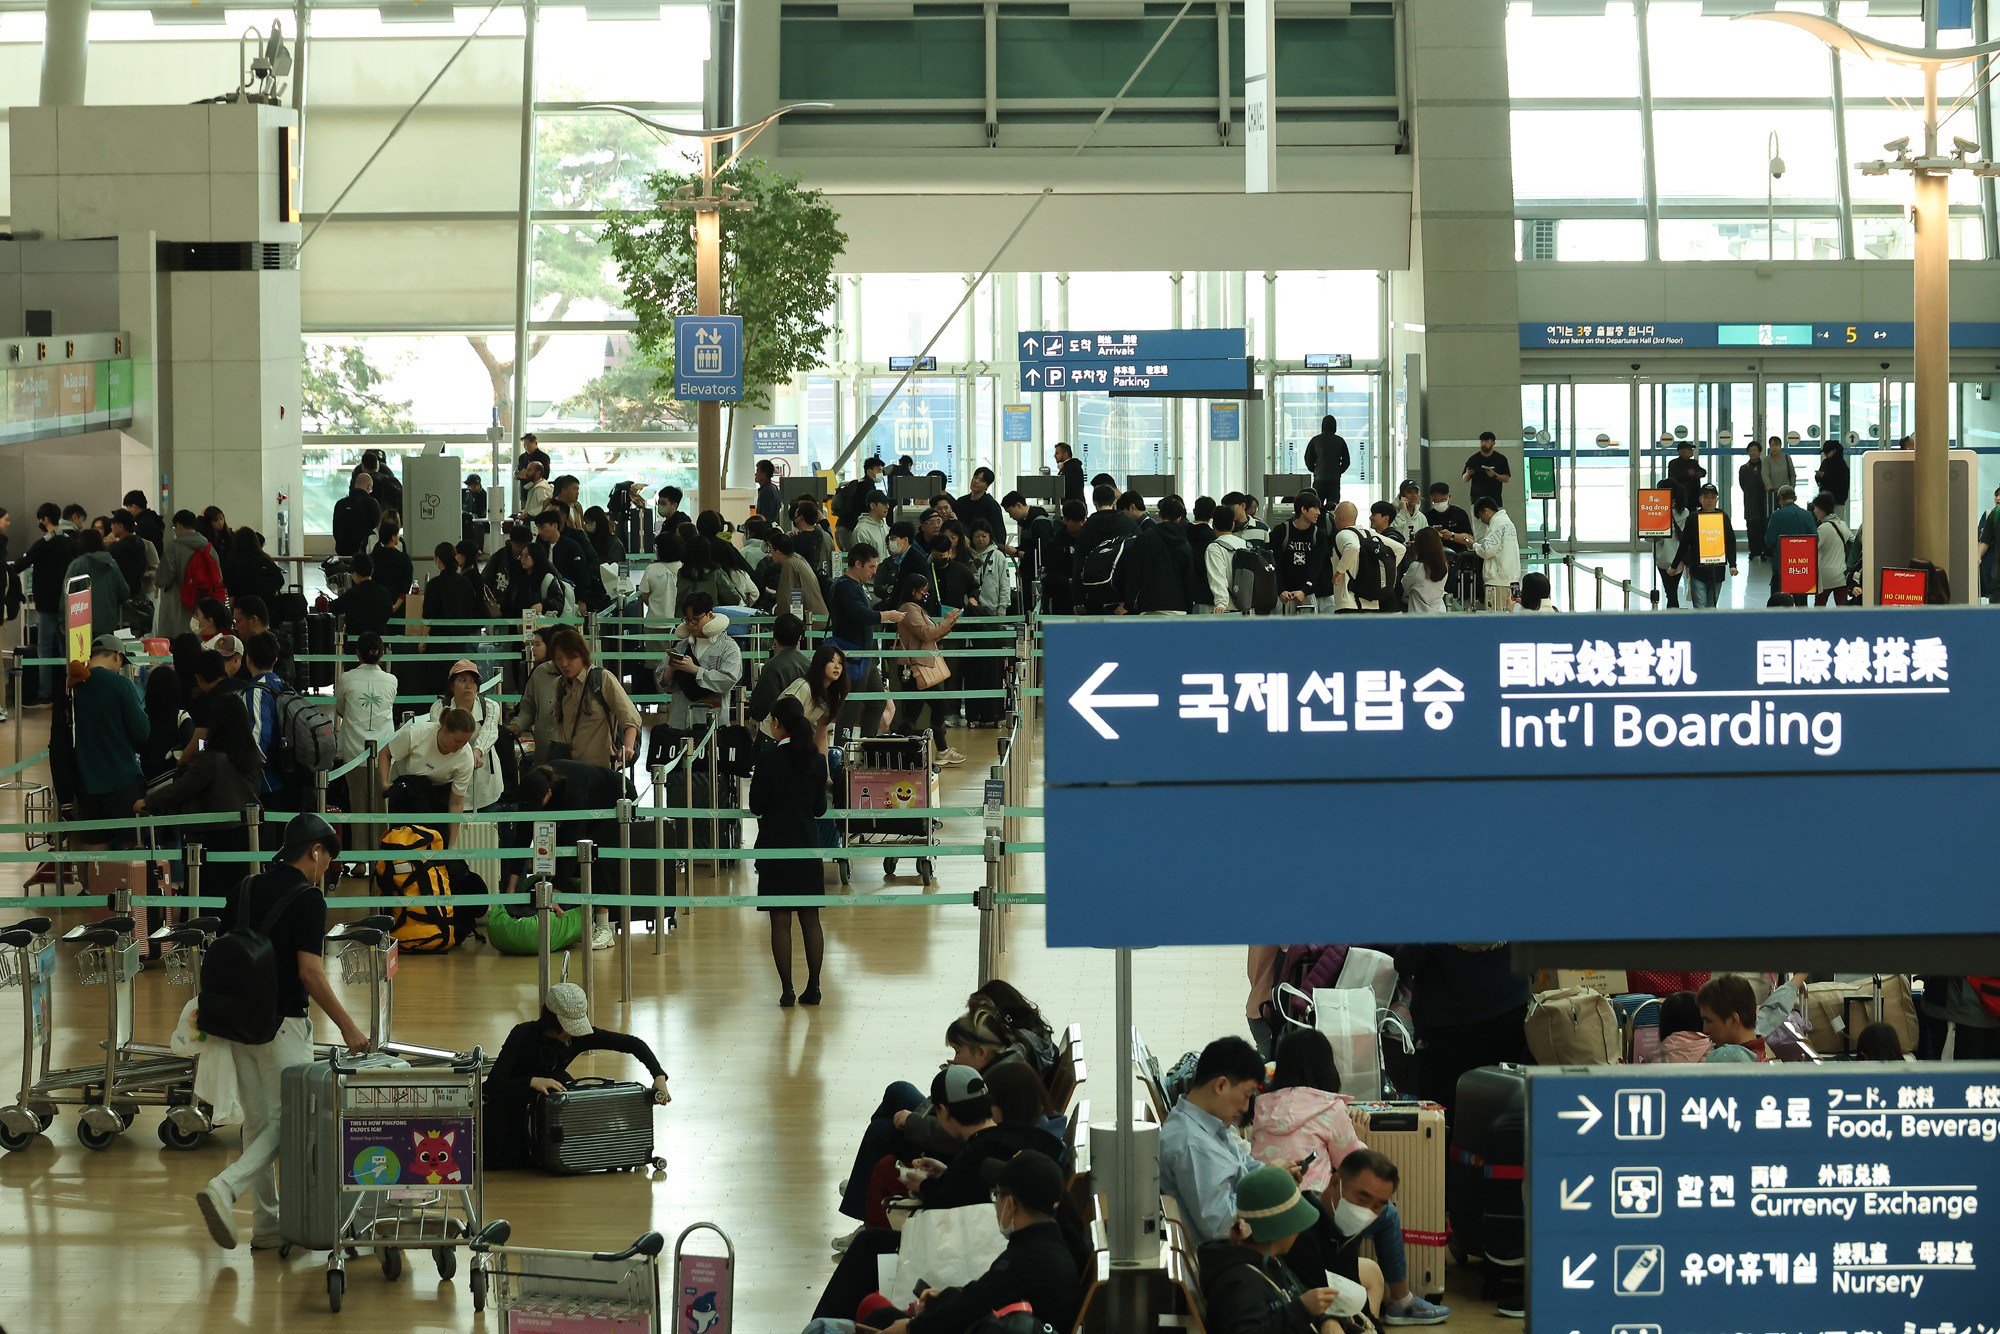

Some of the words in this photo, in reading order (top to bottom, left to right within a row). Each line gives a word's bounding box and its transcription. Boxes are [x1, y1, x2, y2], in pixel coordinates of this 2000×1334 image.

[1546, 325, 1574, 337] 여기는
[1576, 325, 1593, 337] 3층
[1628, 325, 1655, 337] 입니다
[1846, 326, 1857, 343] 5
[1069, 338, 1092, 353] 도착
[1547, 337, 1560, 345] You
[1571, 337, 1585, 345] here
[1595, 337, 1606, 345] the
[1606, 337, 1639, 346] Departures
[1639, 337, 1652, 345] Hall
[1653, 337, 1665, 346] (3rd
[1666, 337, 1684, 346] Floor)
[1097, 346, 1135, 356] Arrivals
[1070, 369, 1108, 384] 주차장
[1113, 376, 1150, 389] Parking
[680, 382, 737, 395] Elevators
[889, 459, 940, 471] Elator
[1534, 469, 1550, 477] Group
[422, 507, 432, 516] kg
[1653, 504, 1669, 512] drop
[1701, 528, 1722, 536] Priority
[1788, 567, 1809, 575] 하노이
[1499, 638, 1698, 688] 国际线登机
[1756, 636, 1949, 685] 国際線搭乗
[1178, 667, 1466, 734] 국제선탑승
[1500, 702, 1594, 748] Int'l
[1613, 699, 1843, 756] Boarding
[655, 745, 736, 762] JODN
[1681, 1096, 1742, 1132] 식사,
[1755, 1095, 1813, 1129] 음료
[1827, 1114, 1893, 1141] Food,
[1901, 1114, 2000, 1142] Beverag
[1751, 1165, 1788, 1189] 両替
[1817, 1162, 1891, 1187] 外币兑换
[1750, 1193, 1857, 1221] Currency
[1863, 1190, 1978, 1220] Exchange
[1832, 1241, 1888, 1266] 授乳室
[1917, 1240, 1974, 1265] 母婴室
[1680, 1251, 1818, 1286] 유아휴게실
[1832, 1271, 1924, 1299] Nursery
